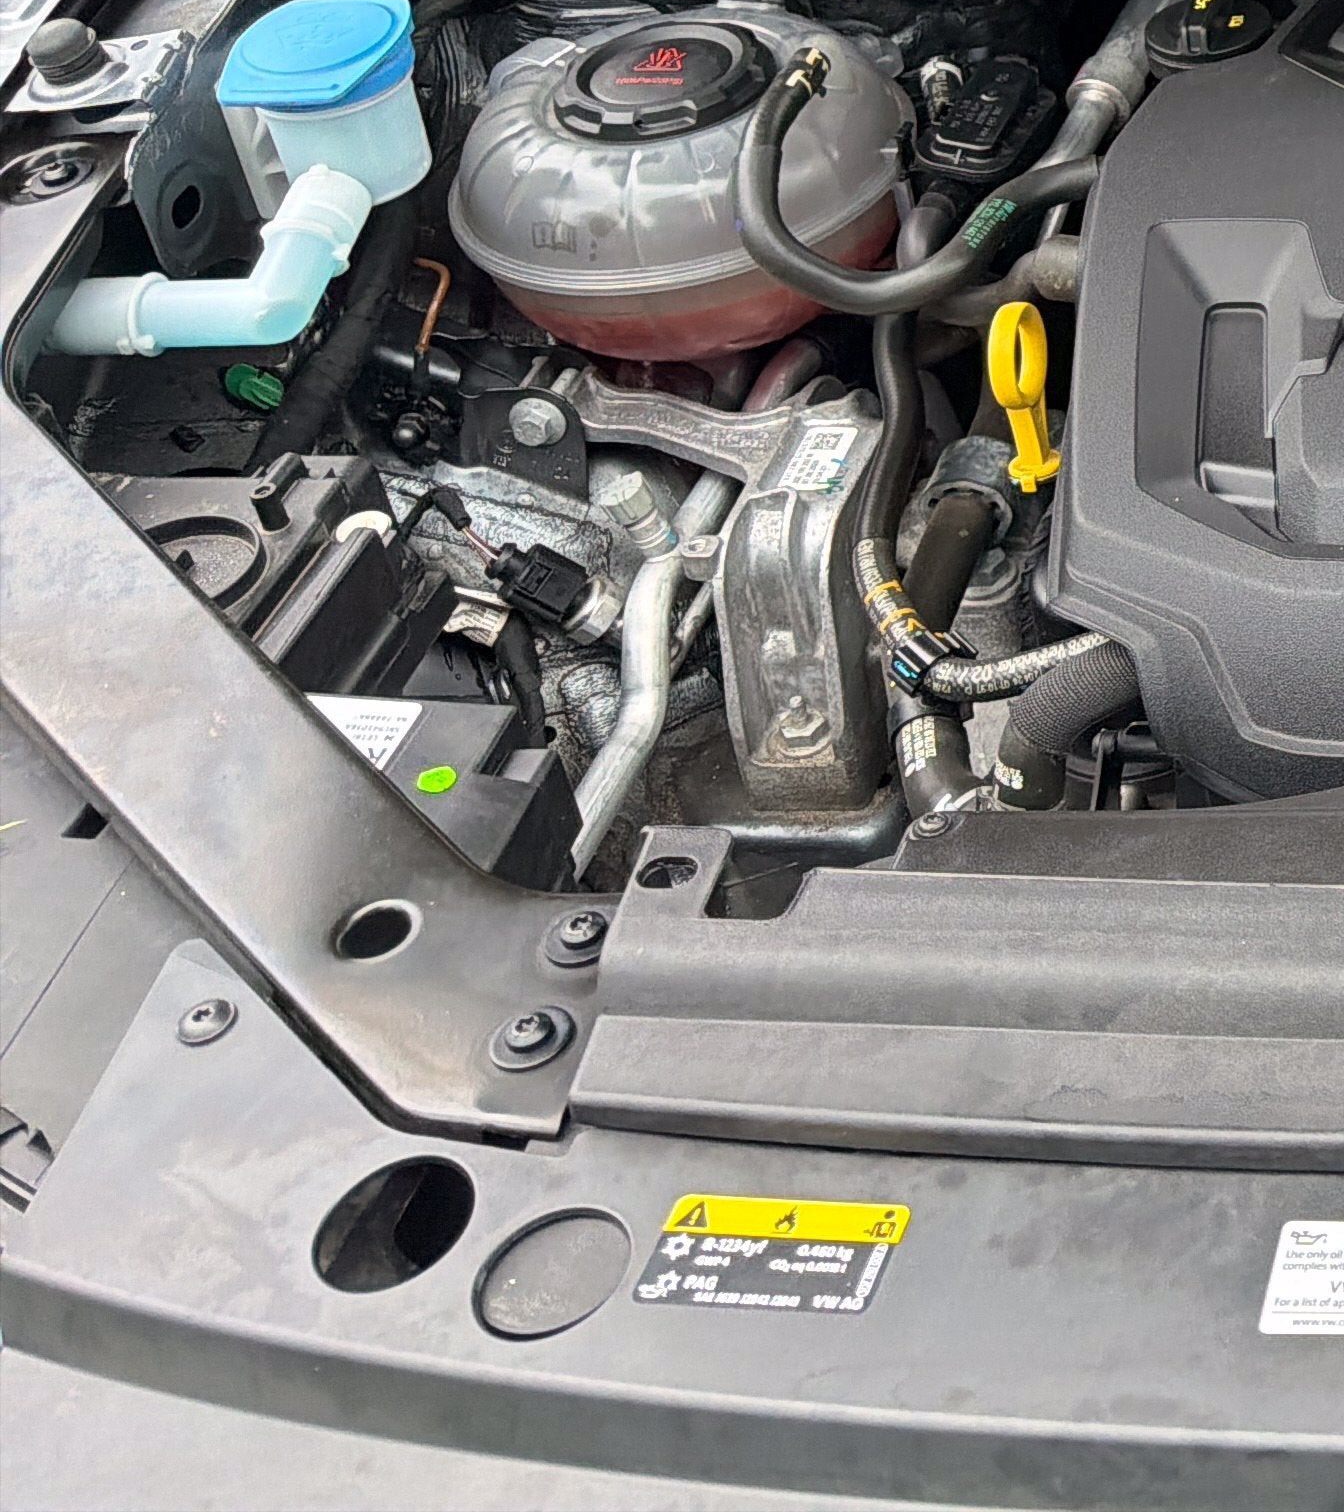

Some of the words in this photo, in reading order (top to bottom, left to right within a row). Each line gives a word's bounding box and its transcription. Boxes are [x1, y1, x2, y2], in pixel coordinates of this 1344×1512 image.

[1285, 1250, 1304, 1259] Use
[1307, 1250, 1328, 1261] only
[1330, 1250, 1343, 1259] oil
[1283, 1262, 1327, 1273] complies
[682, 1275, 719, 1290] PAG
[812, 1295, 840, 1309] VW
[1274, 1298, 1290, 1307] For
[1293, 1299, 1299, 1307] a
[1302, 1298, 1316, 1307] list
[1320, 1298, 1331, 1307] of
